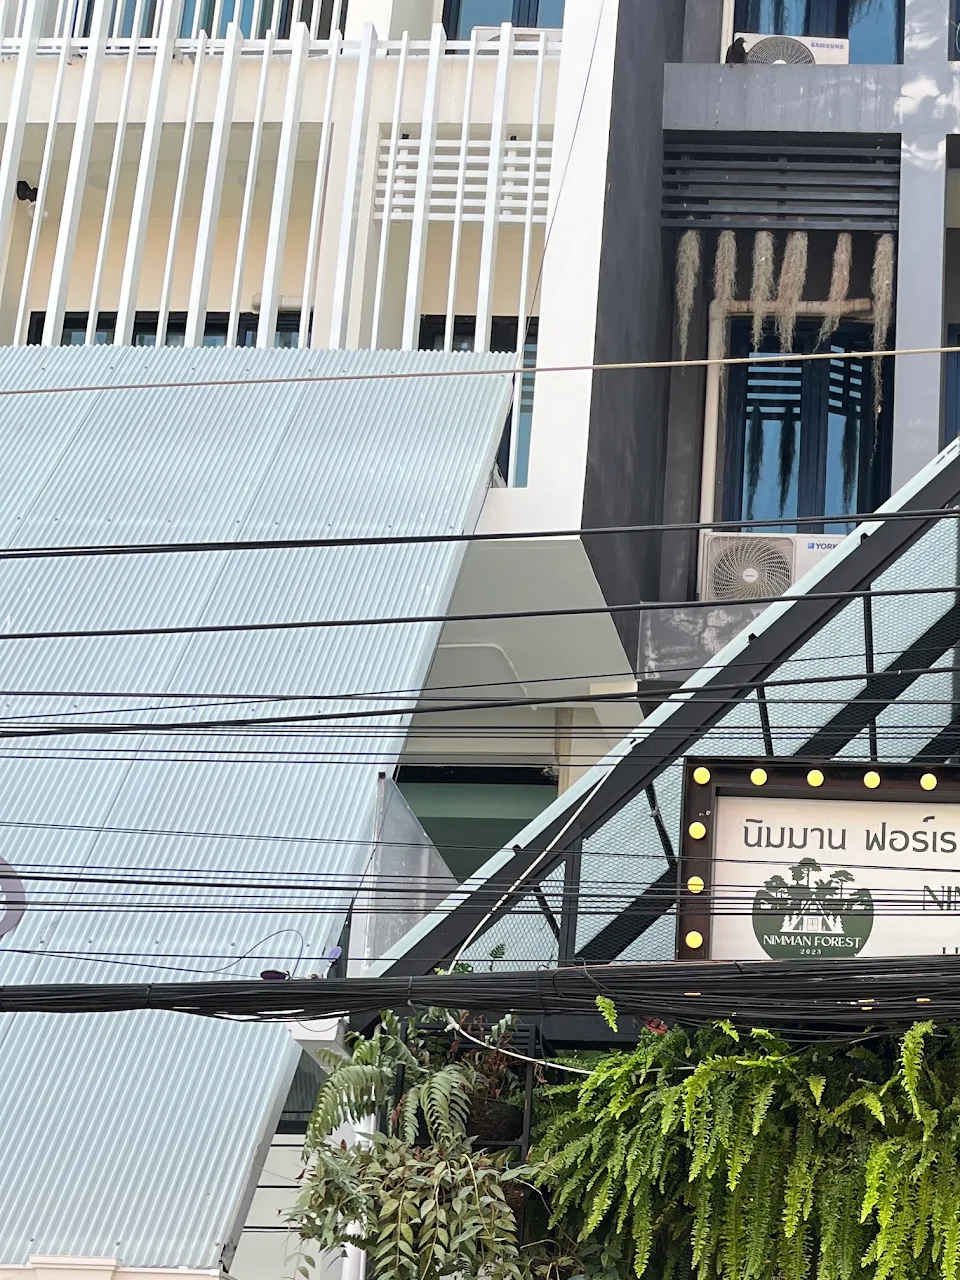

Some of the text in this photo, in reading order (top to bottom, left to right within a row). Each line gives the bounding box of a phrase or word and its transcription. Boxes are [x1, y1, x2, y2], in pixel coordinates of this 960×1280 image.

[811, 42, 844, 50] SAMSUNG
[743, 818, 847, 850] นิมมาน
[763, 935, 861, 948] NIMMAN FOREST
